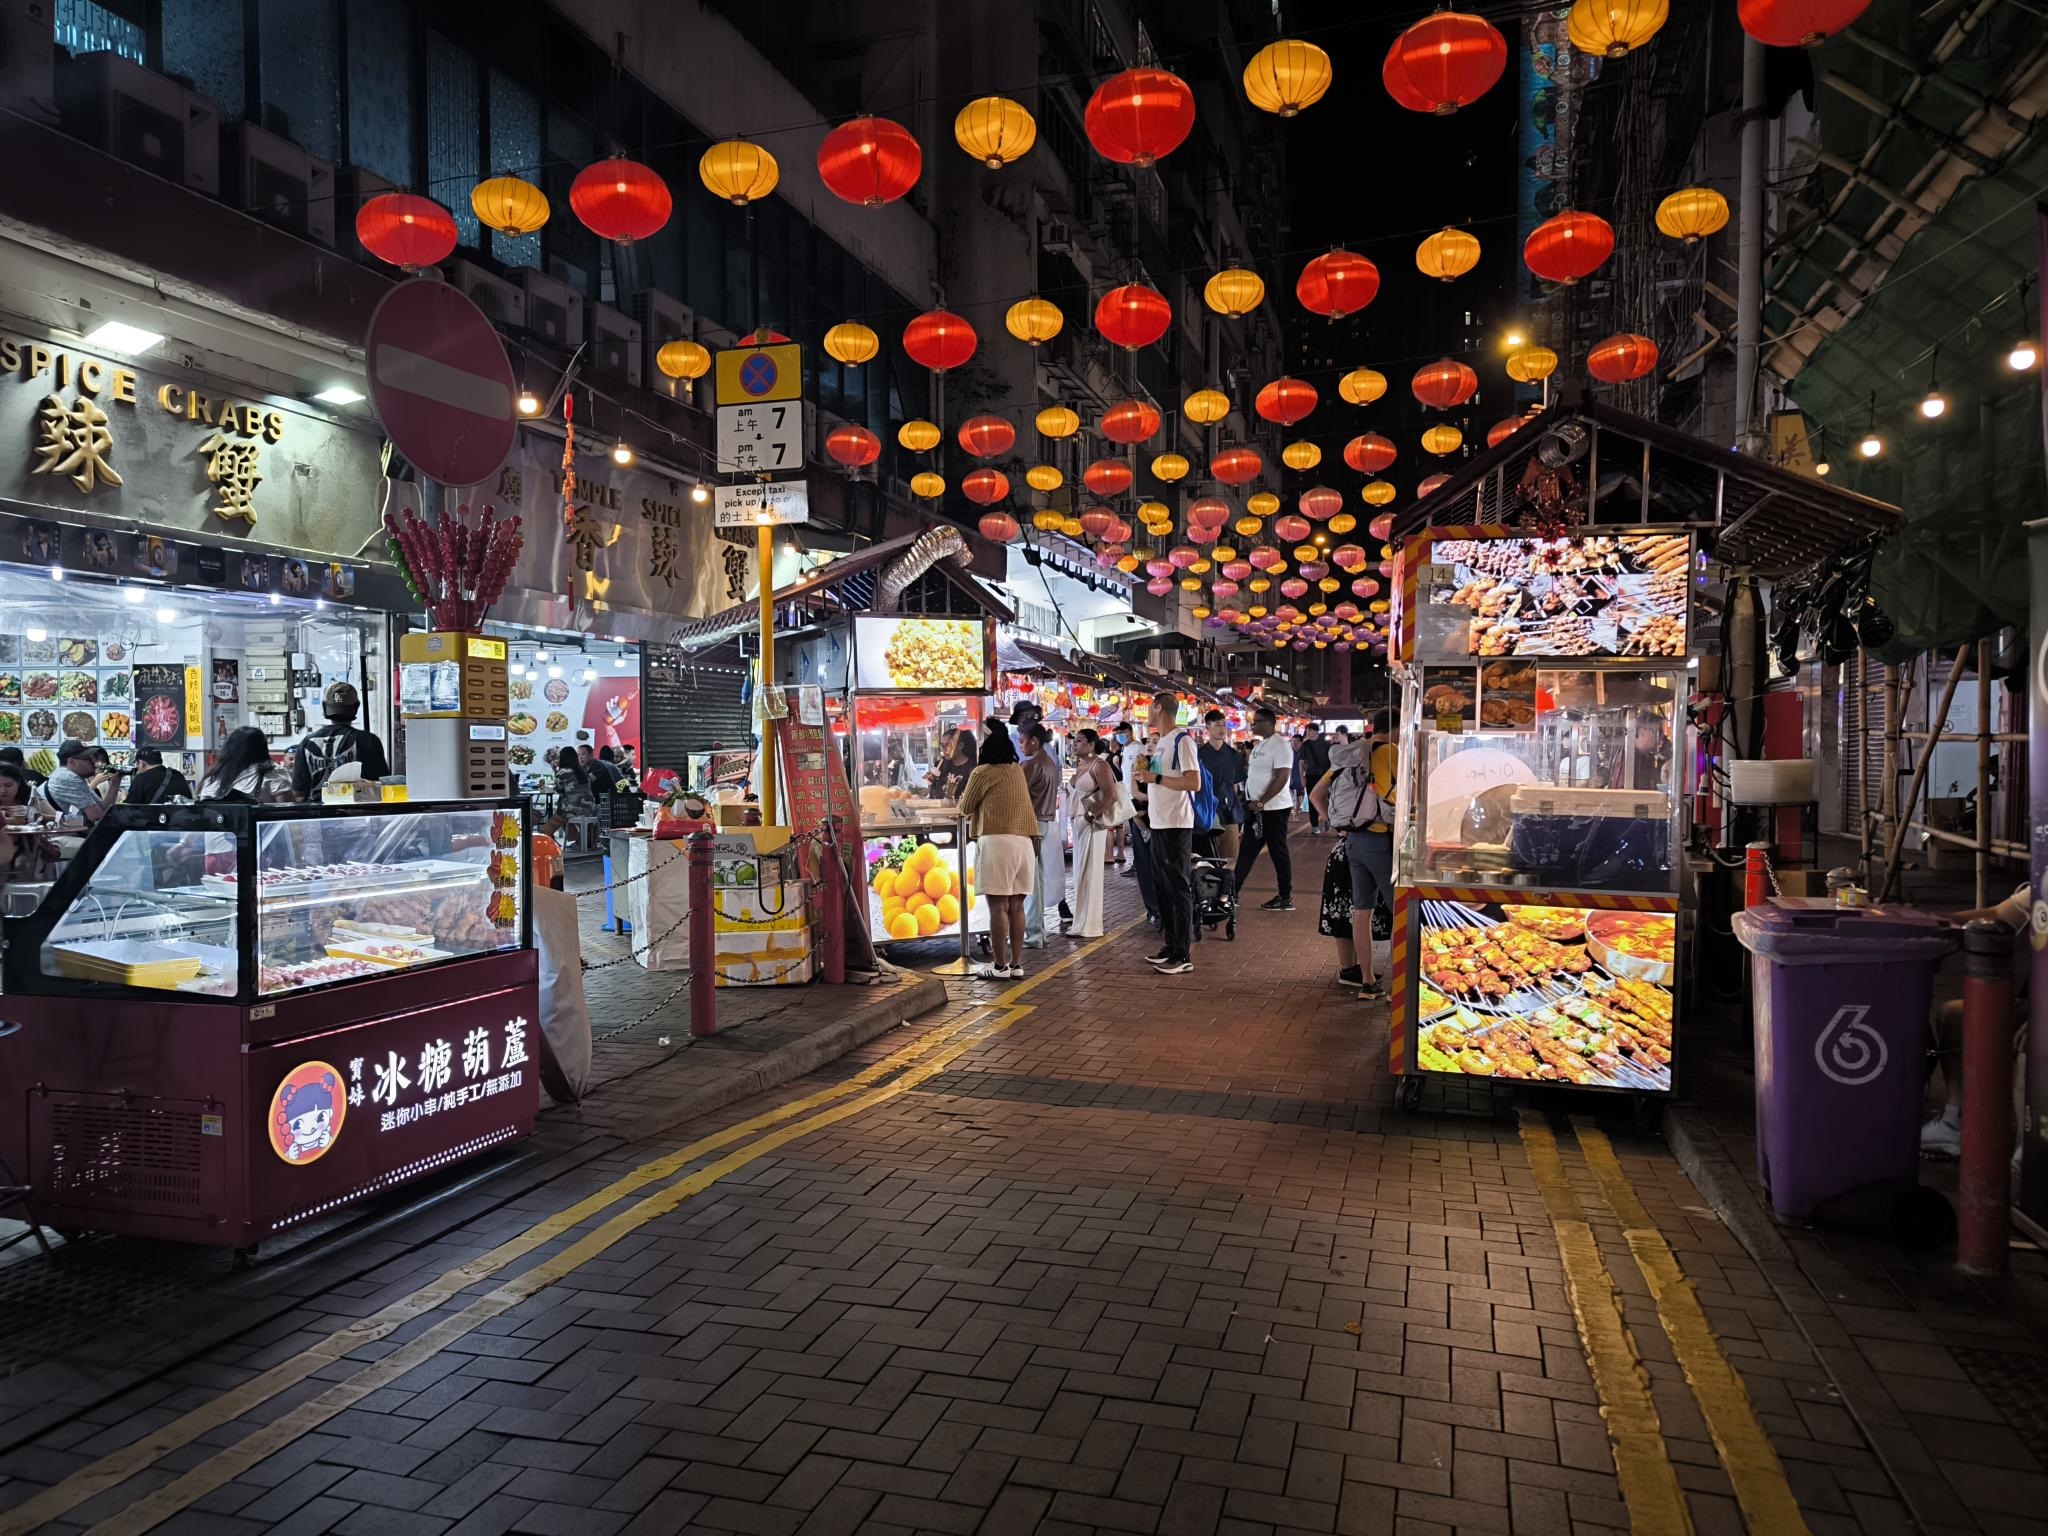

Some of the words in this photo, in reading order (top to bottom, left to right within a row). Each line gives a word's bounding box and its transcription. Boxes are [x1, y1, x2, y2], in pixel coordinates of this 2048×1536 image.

[0, 337, 137, 403] SPICE
[159, 383, 284, 441] CRABS
[738, 408, 753, 417] am
[772, 406, 786, 430] 7
[733, 418, 758, 432] 上午
[31, 395, 124, 494] 辣
[738, 443, 753, 457] pm
[772, 442, 786, 465] 7
[733, 454, 758, 469] 下午
[550, 469, 622, 511] TMPLE
[736, 487, 766, 498] Except
[768, 484, 786, 495] taxi
[724, 499, 743, 509] pick
[1429, 567, 1447, 582] 14
[371, 1016, 529, 1106] 冰糖葫蘆
[348, 1057, 366, 1108] 寶妹
[380, 1070, 522, 1133] 迷你小串/純手工/無添加
